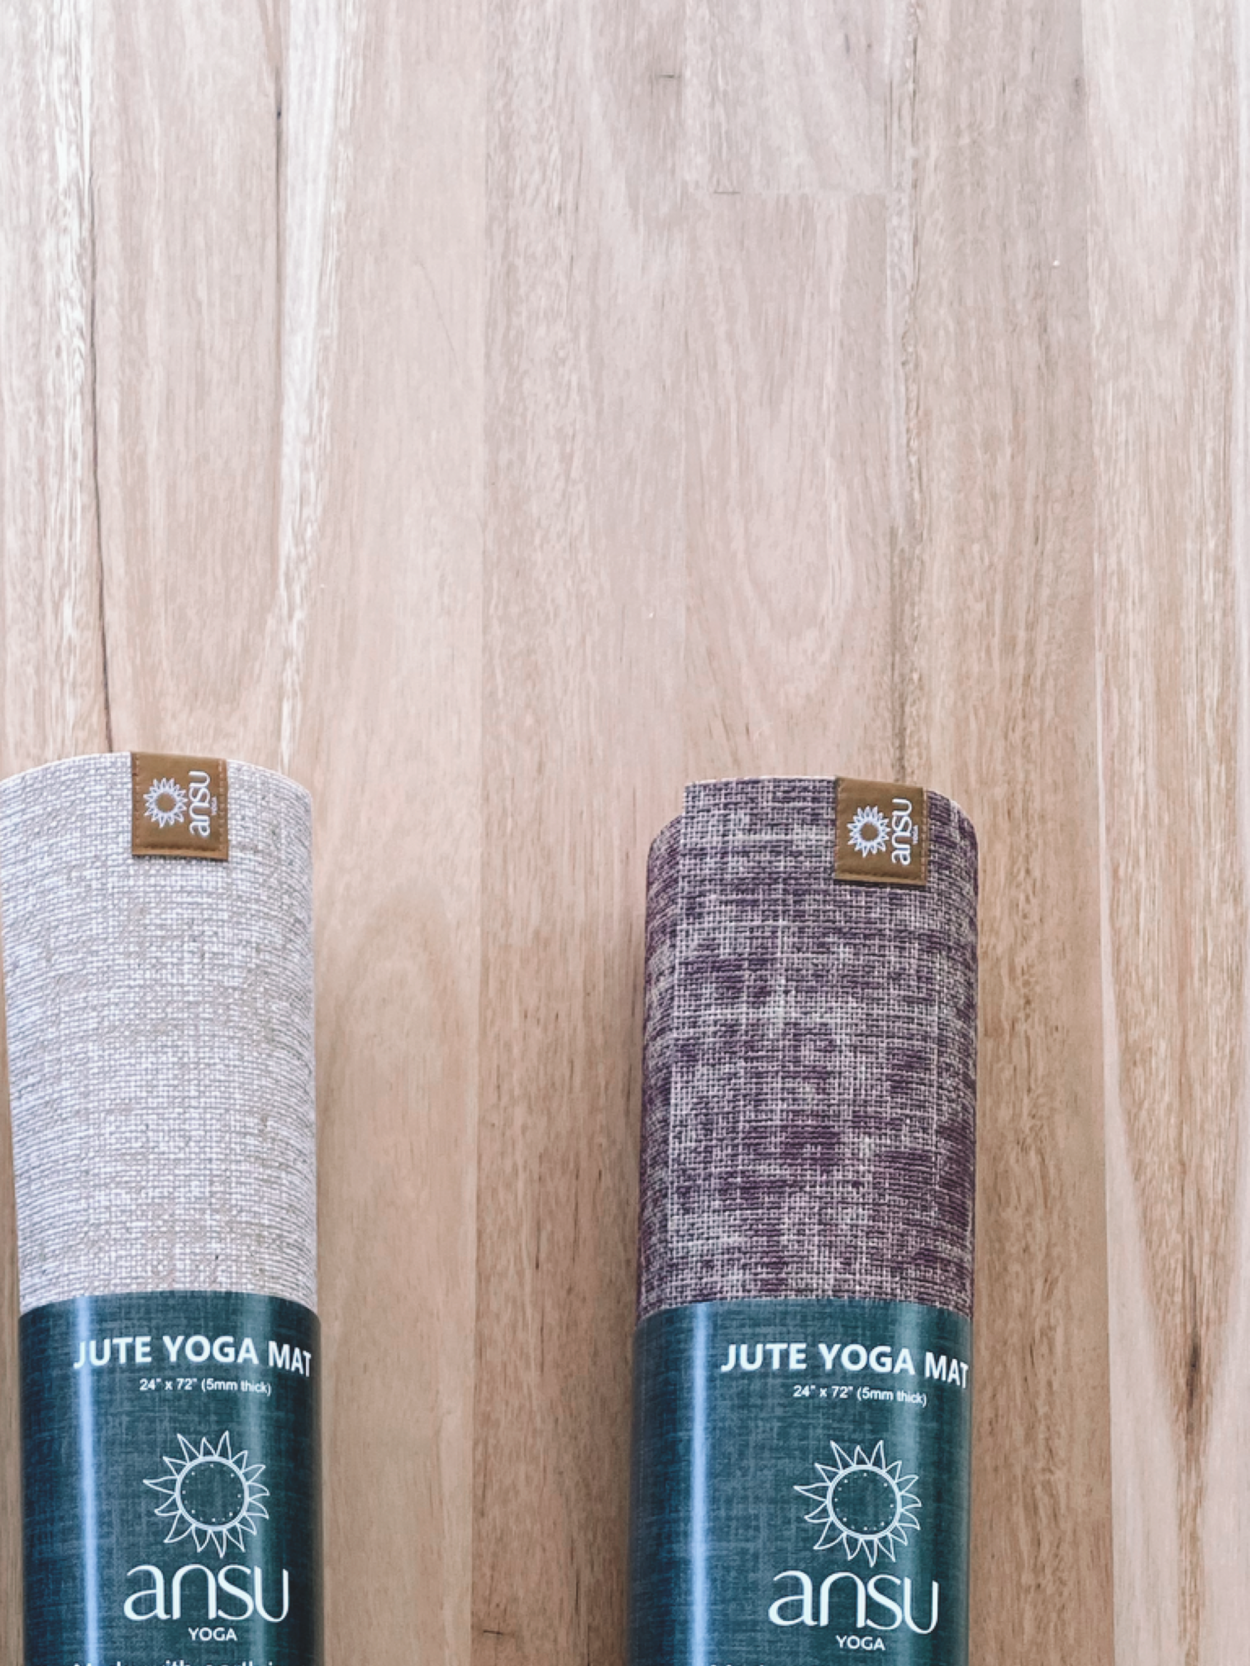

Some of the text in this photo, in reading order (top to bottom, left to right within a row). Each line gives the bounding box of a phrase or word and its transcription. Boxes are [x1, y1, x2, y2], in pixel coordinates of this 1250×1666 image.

[189, 770, 210, 836] ansu
[892, 798, 912, 866] ansu
[73, 1335, 312, 1377] JUTE YOGA MAT
[720, 1343, 969, 1389] JUTE YOGA MAT
[139, 1377, 272, 1396] 24" x 72" (5mm thick)
[793, 1385, 927, 1408] 24" x 72" (5mm thick)
[123, 1563, 290, 1623] ansu
[768, 1570, 939, 1635] ansu
[188, 1627, 238, 1642] YOGA
[835, 1635, 886, 1651] YOGA
